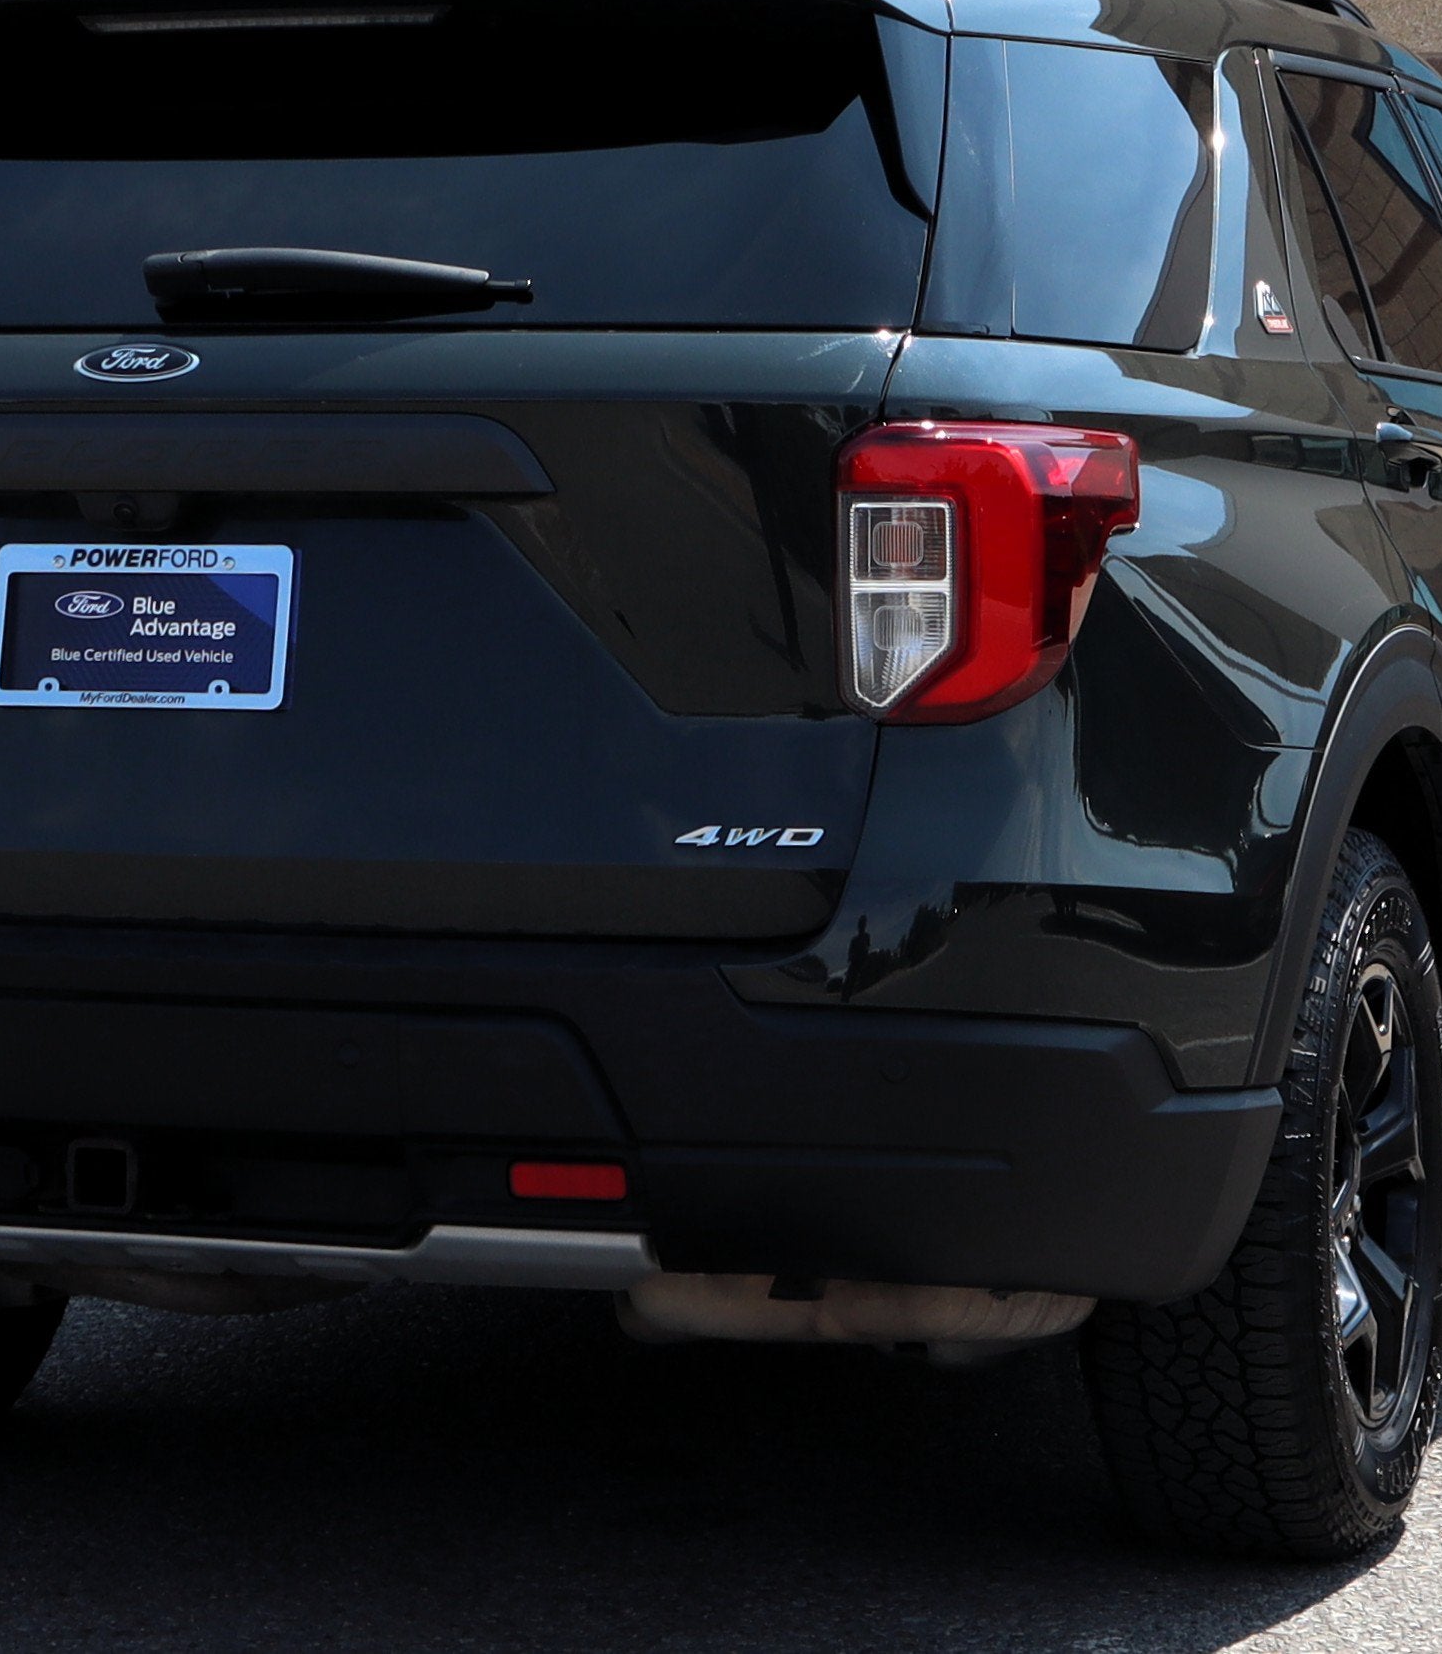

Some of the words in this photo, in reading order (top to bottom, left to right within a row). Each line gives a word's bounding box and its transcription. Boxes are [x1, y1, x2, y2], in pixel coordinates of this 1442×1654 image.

[101, 348, 170, 370] Ford
[70, 548, 219, 569] POWERFORD
[67, 595, 112, 614] Ford
[131, 596, 177, 615] Blue
[129, 617, 237, 640] Advantage
[50, 648, 82, 662] Blue
[83, 648, 144, 663] Certified
[145, 649, 182, 663] Used
[184, 649, 235, 664] Vehicle
[79, 692, 186, 705] MyFordDealer.com
[674, 825, 825, 847] 4WD
